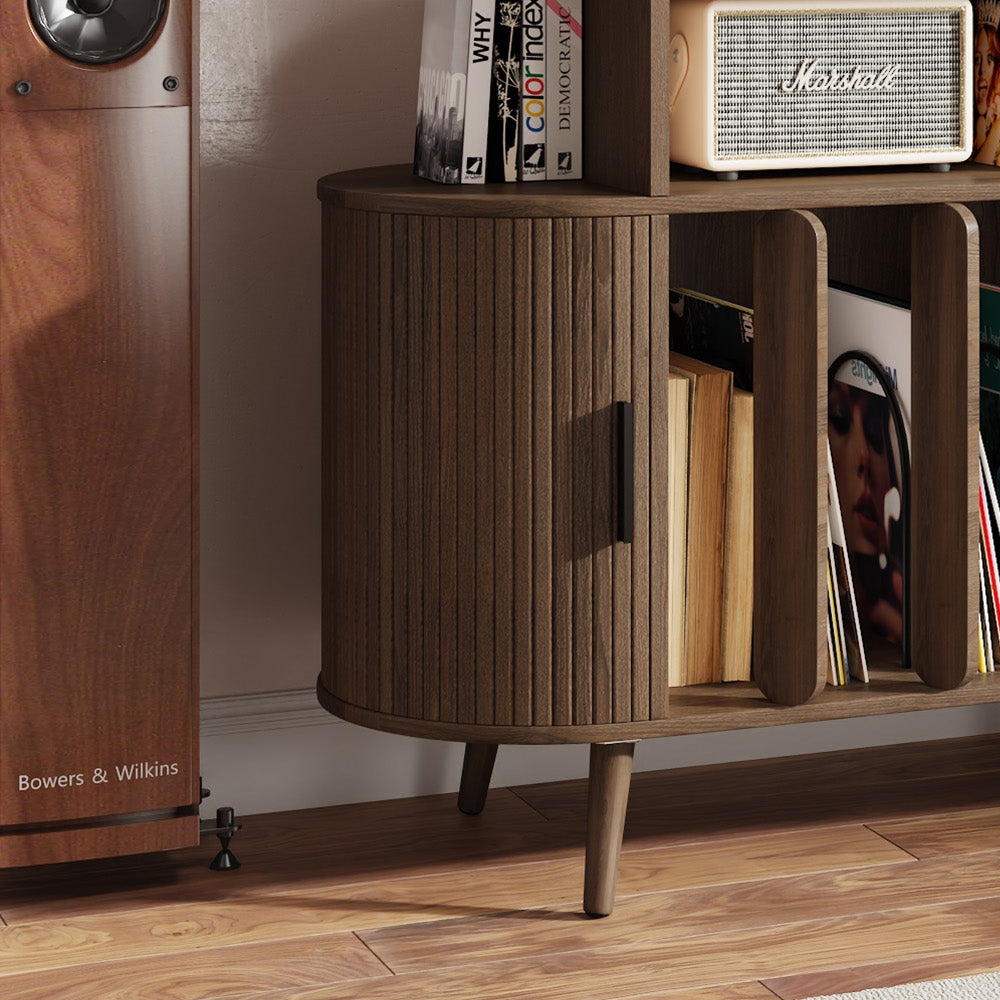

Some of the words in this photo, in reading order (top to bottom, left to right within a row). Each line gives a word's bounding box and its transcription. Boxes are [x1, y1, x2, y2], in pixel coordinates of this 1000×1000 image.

[472, 12, 491, 64] WHY
[559, 6, 572, 131] DEMOCRATIC
[782, 58, 901, 93] Marshall
[522, 65, 545, 132] color
[18, 773, 84, 791] Bowers
[92, 767, 108, 784] &
[115, 760, 179, 781] Wilkins
